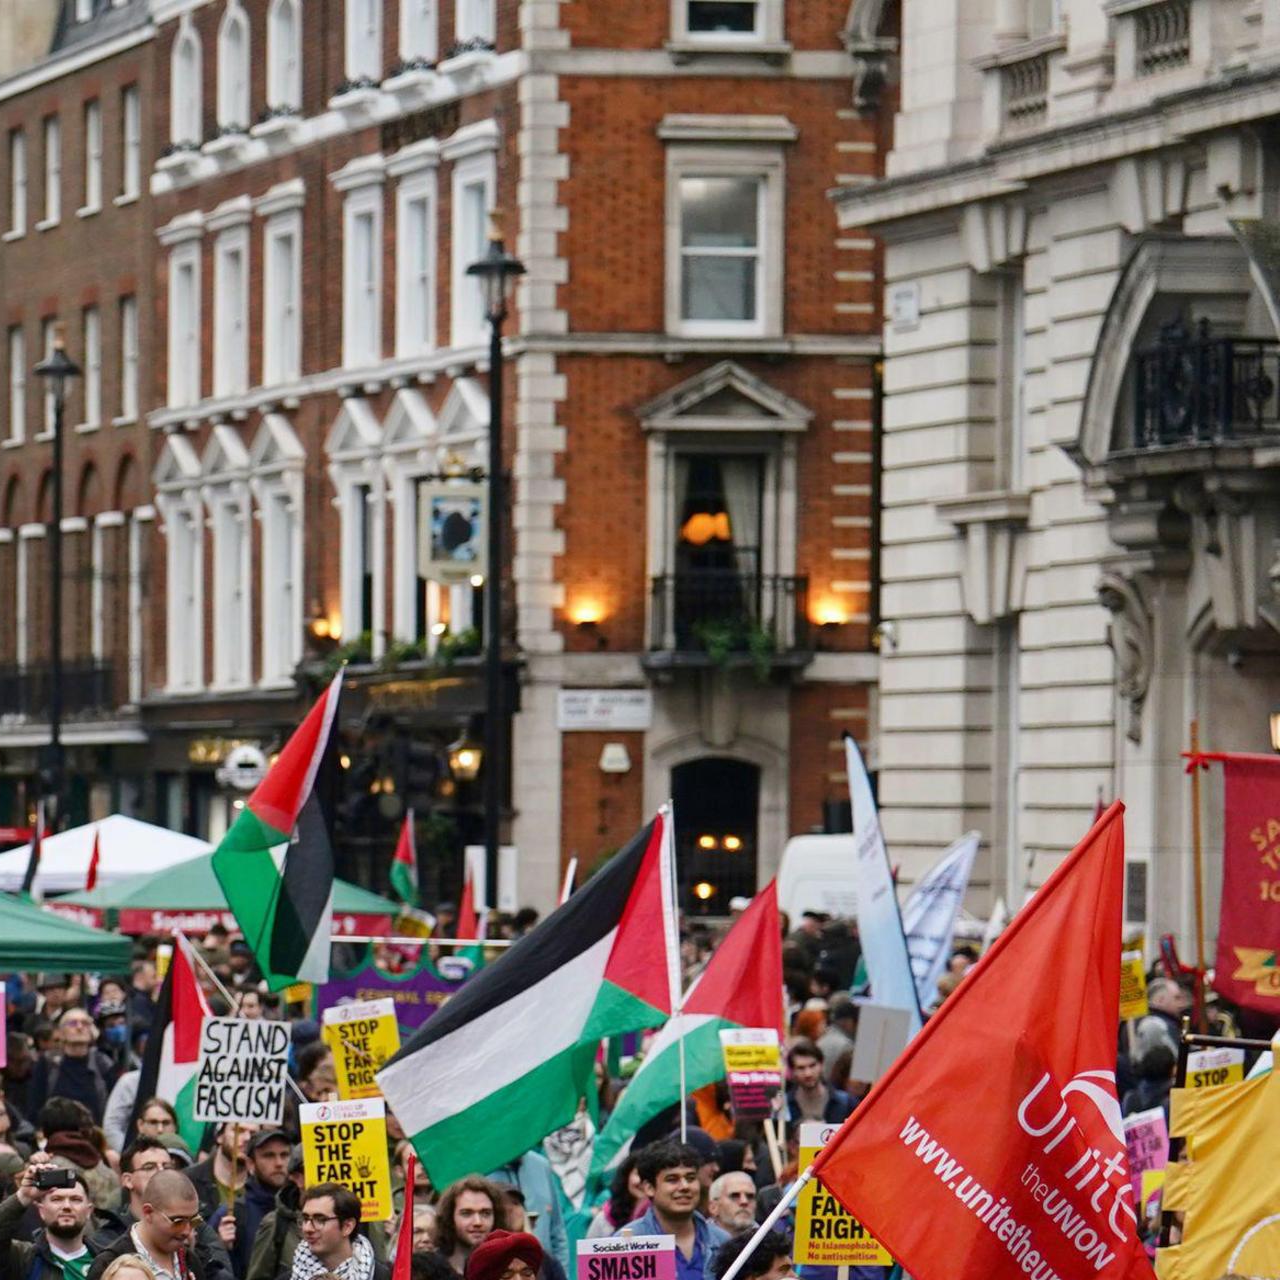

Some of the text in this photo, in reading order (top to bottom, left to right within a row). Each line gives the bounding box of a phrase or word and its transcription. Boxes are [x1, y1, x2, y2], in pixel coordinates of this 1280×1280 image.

[203, 1020, 288, 1056] STAND
[198, 1056, 287, 1084] AGAINST
[196, 1084, 284, 1121] FASCISM
[821, 1252, 878, 1261] antisemitism
[822, 1240, 879, 1251] Islamophobia
